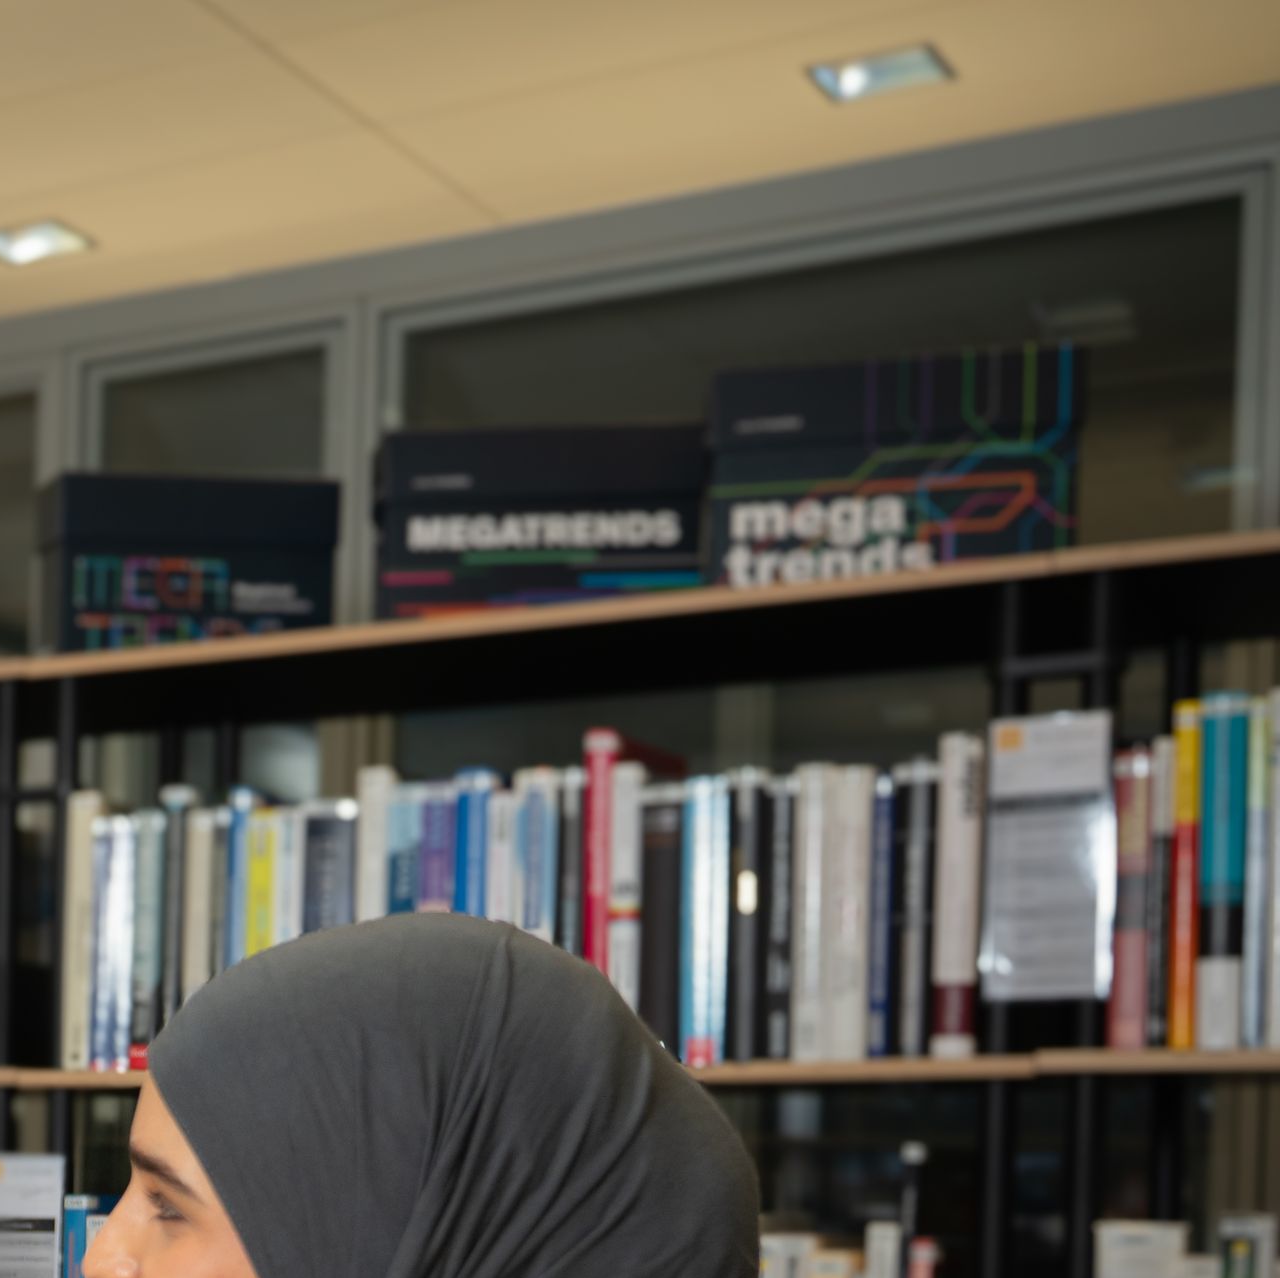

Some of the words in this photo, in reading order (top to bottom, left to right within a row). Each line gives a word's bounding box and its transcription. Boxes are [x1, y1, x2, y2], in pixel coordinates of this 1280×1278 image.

[406, 511, 681, 551] MEGATRENDS
[730, 495, 907, 547] mega
[725, 538, 933, 588] trends
